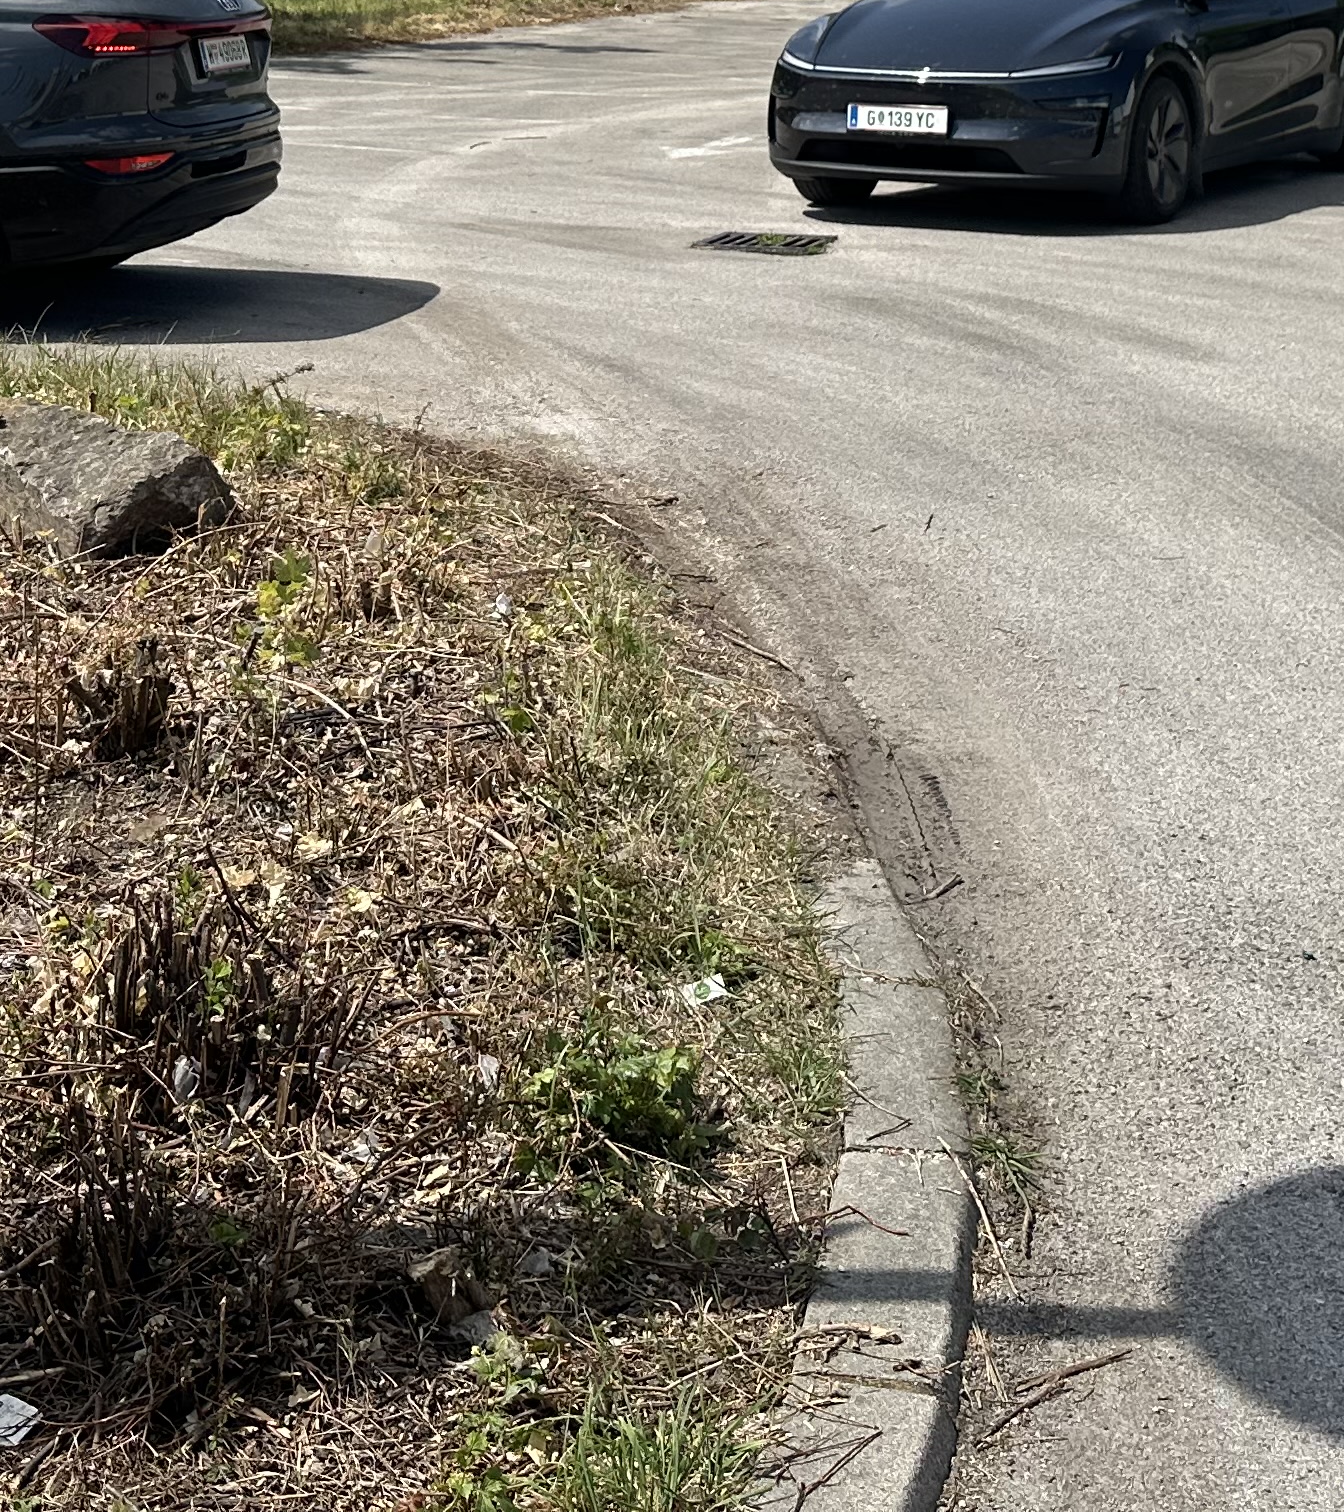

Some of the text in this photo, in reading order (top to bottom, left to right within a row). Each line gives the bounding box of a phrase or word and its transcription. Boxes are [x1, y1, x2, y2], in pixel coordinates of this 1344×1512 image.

[867, 110, 875, 126] G
[888, 111, 912, 127] 139
[916, 112, 935, 128] YC
